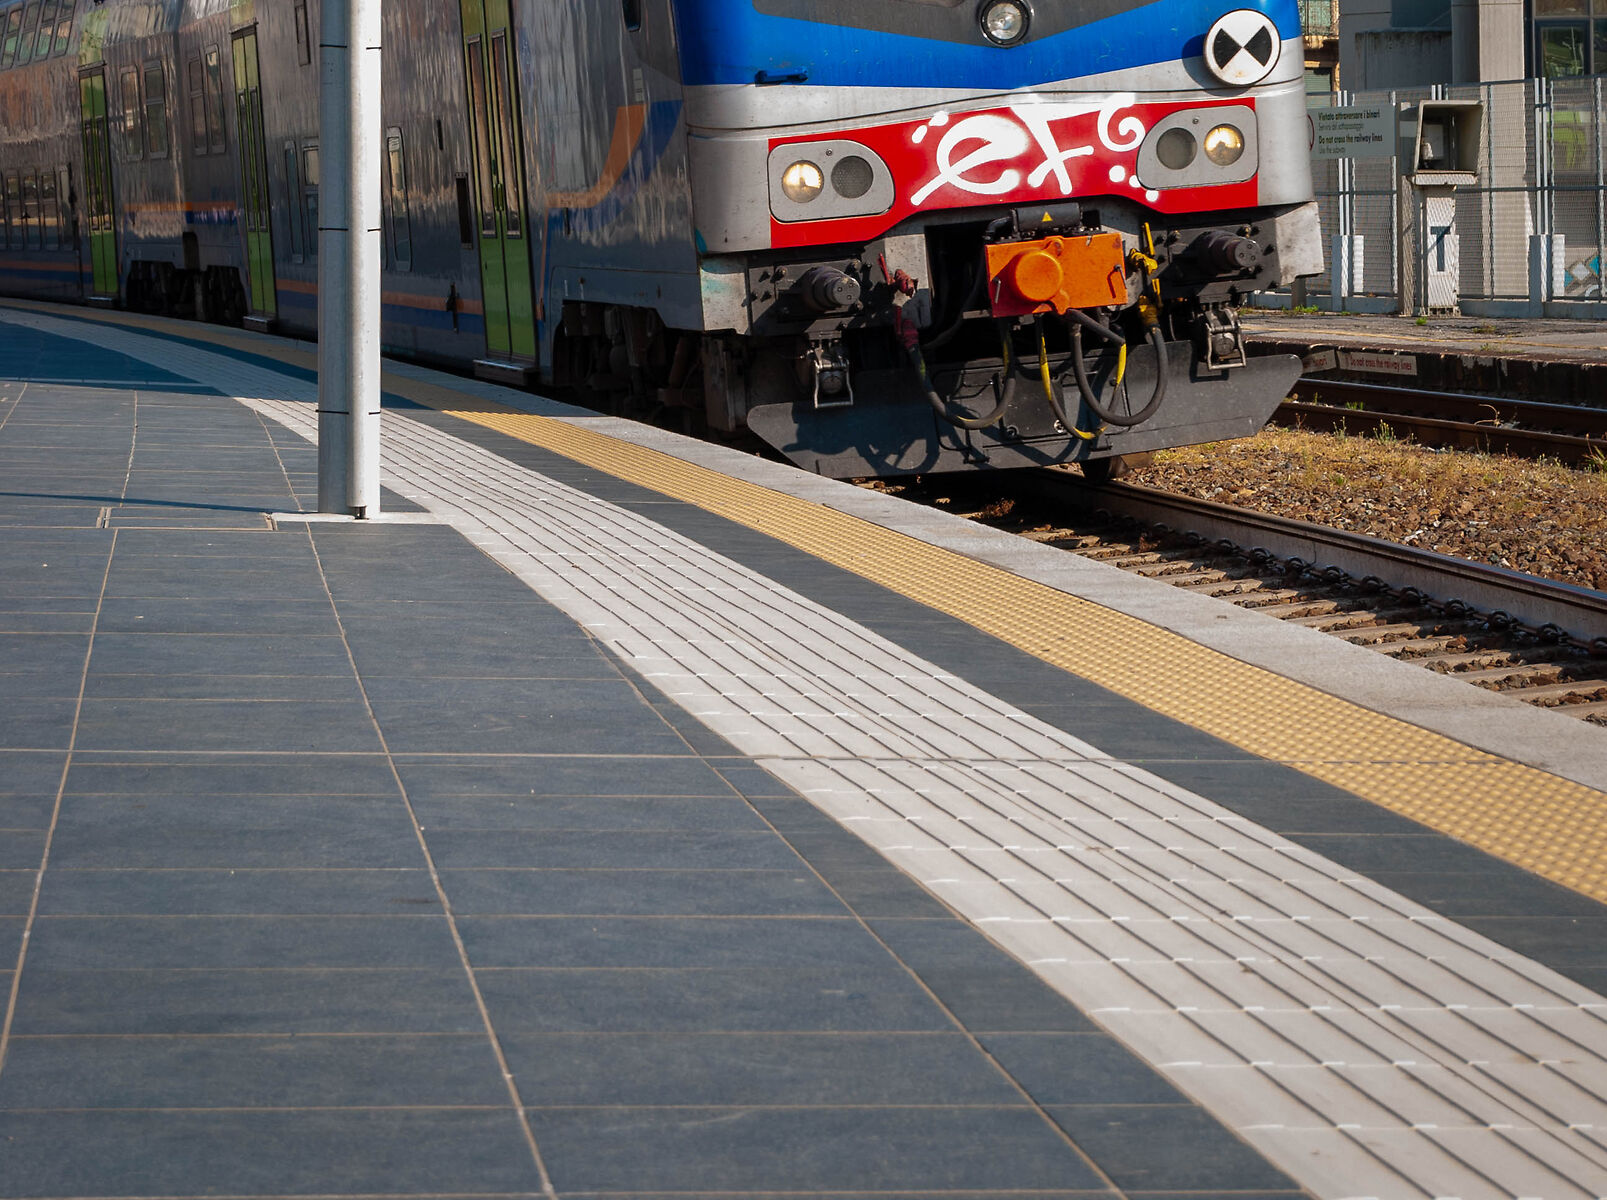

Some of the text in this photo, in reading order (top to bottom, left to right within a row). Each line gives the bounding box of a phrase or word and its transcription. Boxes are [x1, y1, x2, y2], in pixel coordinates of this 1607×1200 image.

[1318, 135, 1325, 144] Do
[1326, 135, 1334, 144] not
[1334, 135, 1345, 144] cross
[1354, 132, 1371, 144] railway
[1371, 132, 1383, 142] lines
[1430, 226, 1451, 272] T
